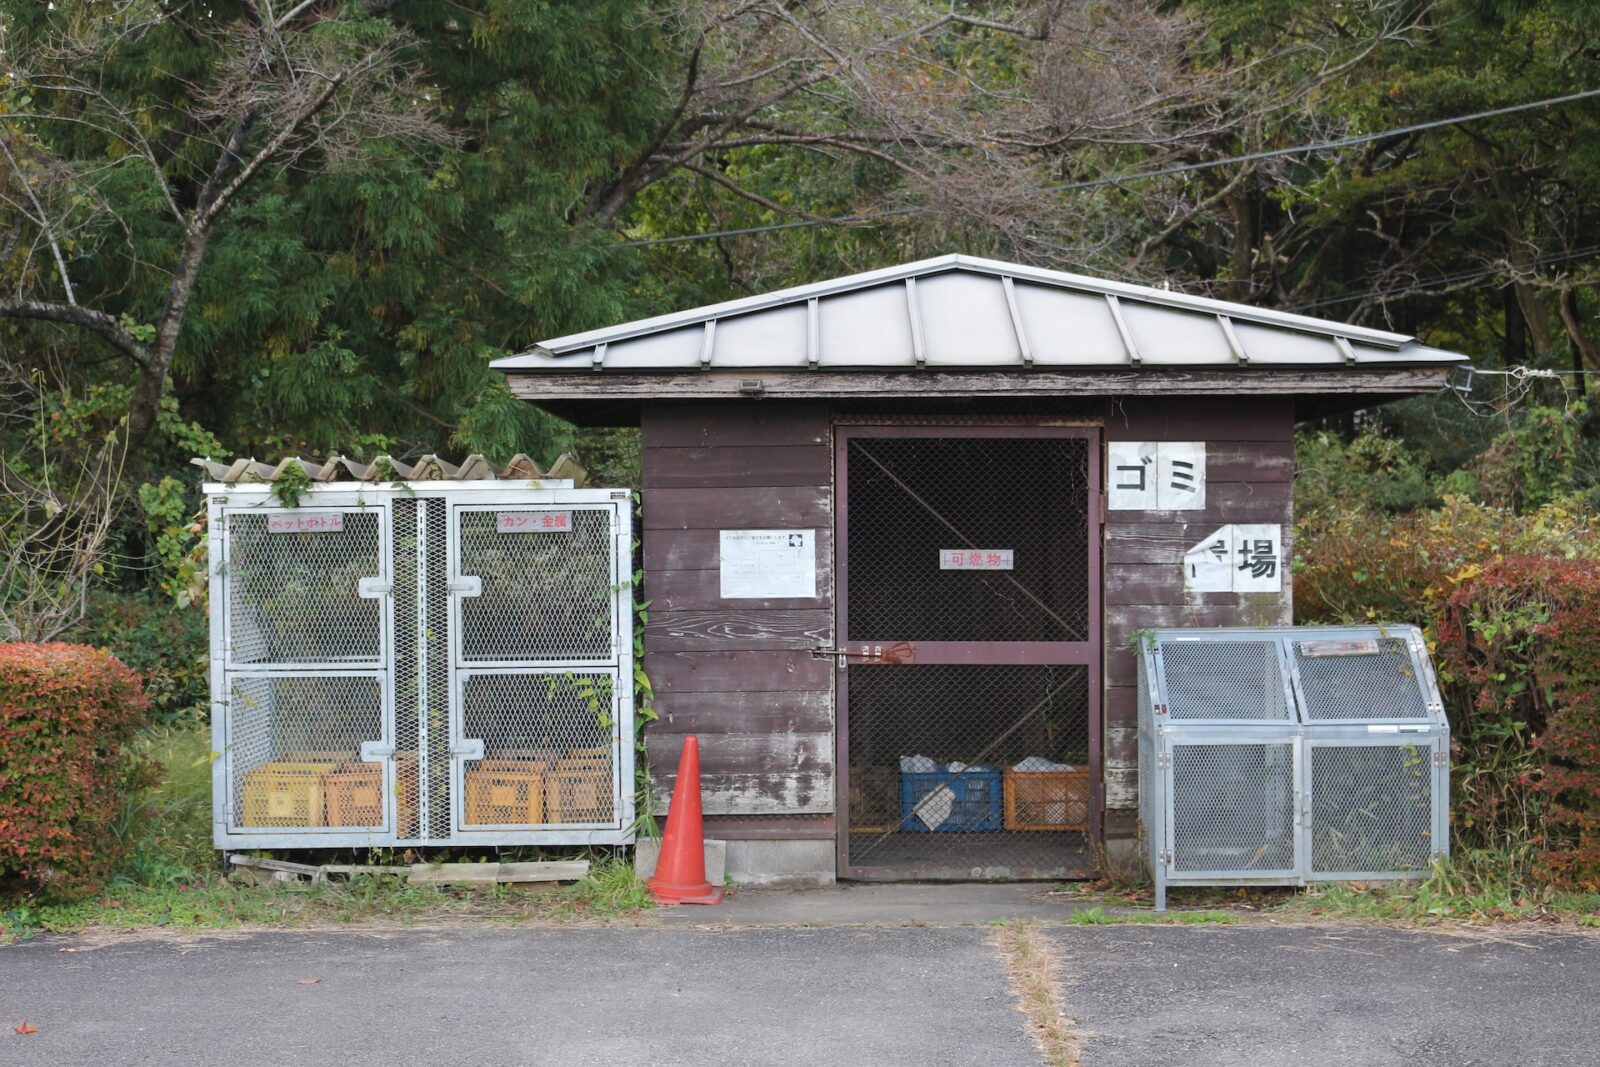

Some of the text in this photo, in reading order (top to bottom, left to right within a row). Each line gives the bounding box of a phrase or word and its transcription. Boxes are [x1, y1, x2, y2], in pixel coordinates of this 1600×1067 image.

[1116, 455, 1197, 494] ゴミ
[951, 551, 1001, 567] 可燃物
